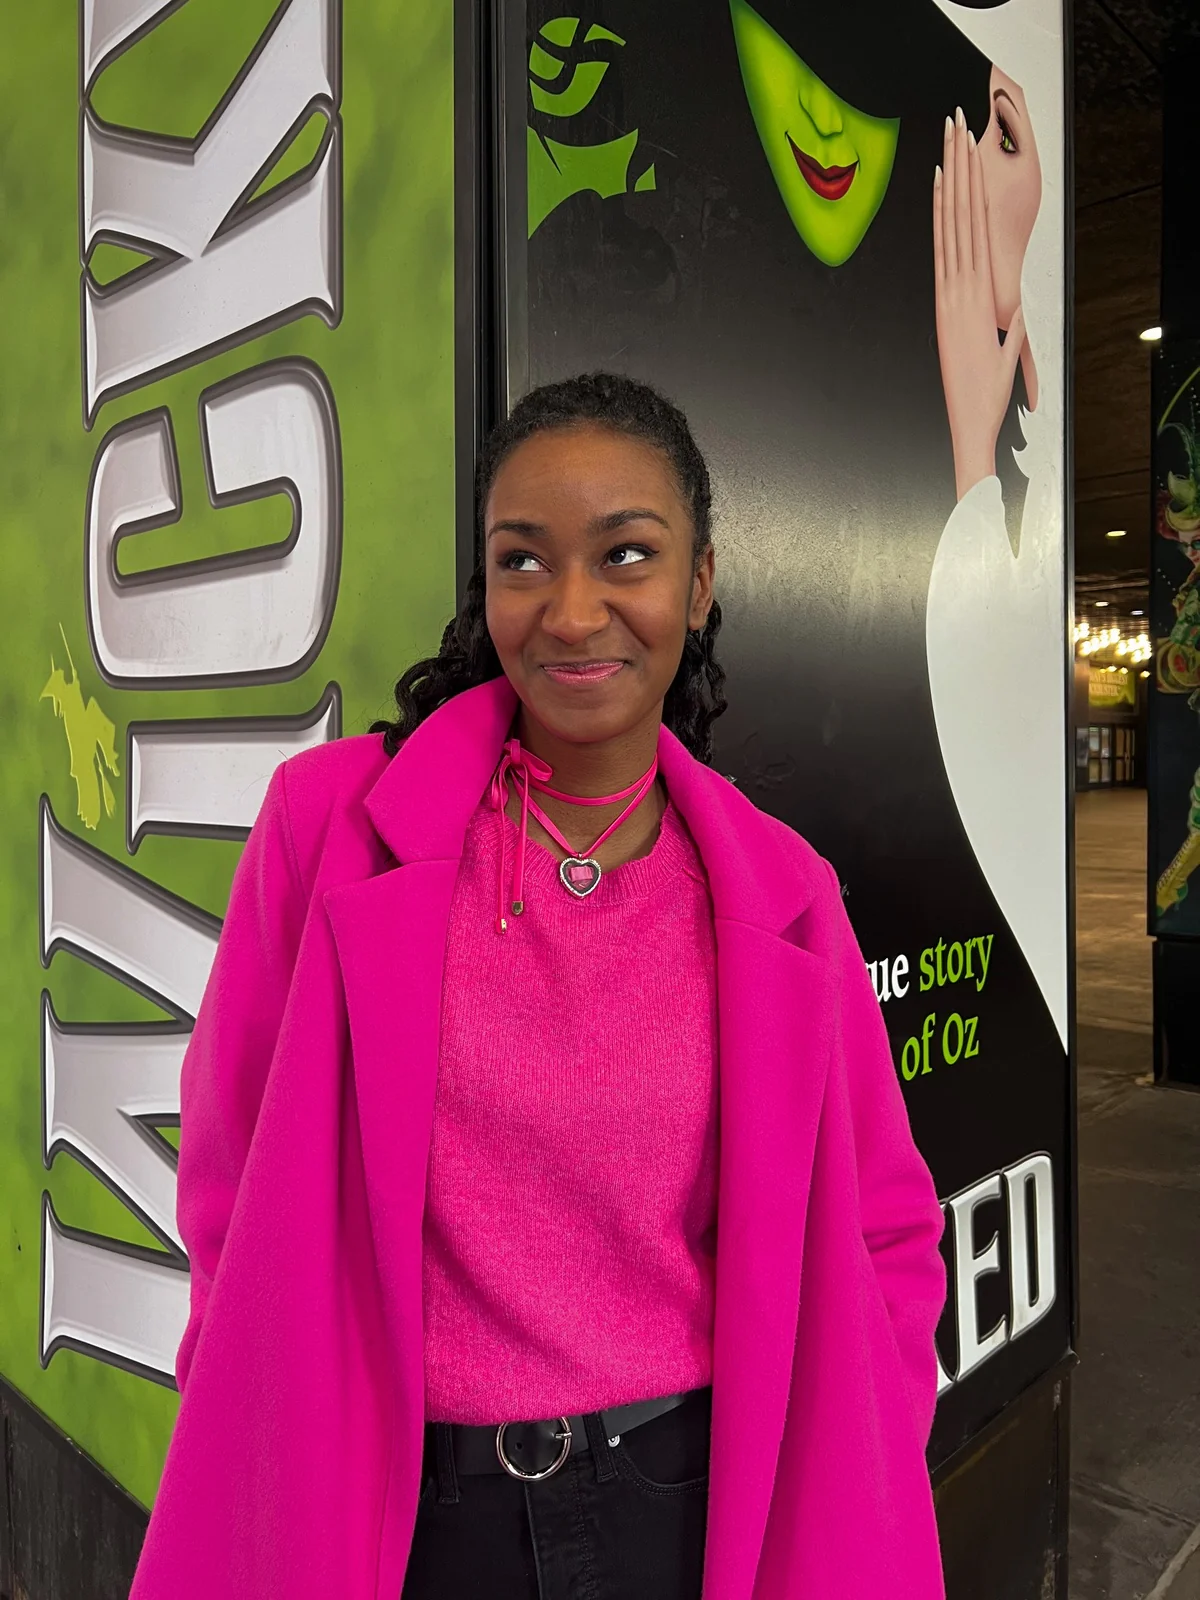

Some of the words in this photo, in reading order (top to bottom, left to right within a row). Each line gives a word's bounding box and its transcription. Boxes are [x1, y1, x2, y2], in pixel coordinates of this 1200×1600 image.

[919, 933, 995, 992] story
[901, 1012, 936, 1081] of
[942, 1012, 980, 1065] Oz
[936, 1151, 1056, 1392] ED
